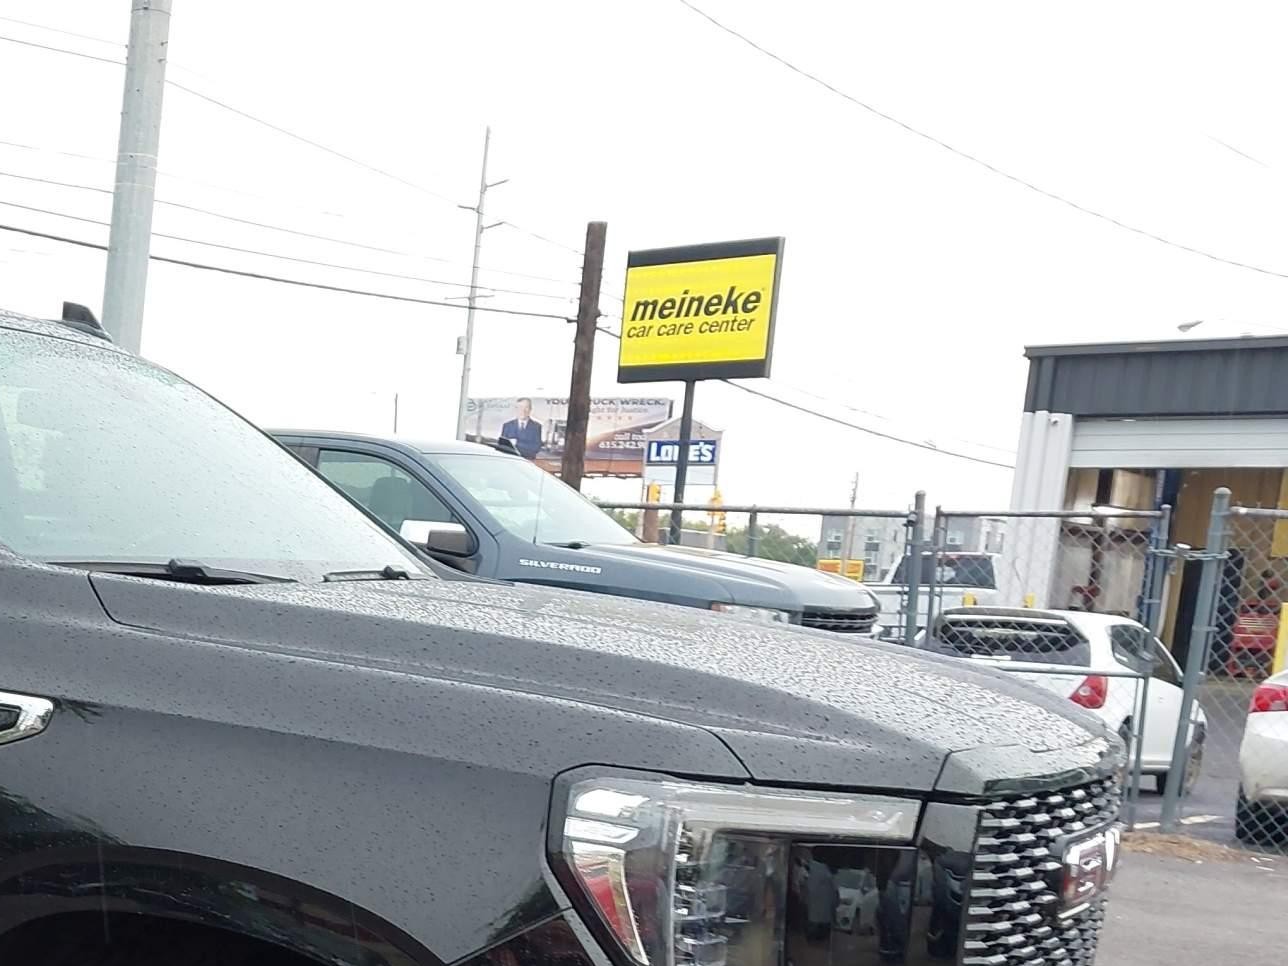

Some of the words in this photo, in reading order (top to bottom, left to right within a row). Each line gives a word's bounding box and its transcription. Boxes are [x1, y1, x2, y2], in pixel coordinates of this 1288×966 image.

[630, 286, 761, 321] meineke
[627, 323, 654, 338] car
[657, 321, 694, 337] care
[698, 316, 756, 335] center
[519, 559, 602, 574] SILVERADO
